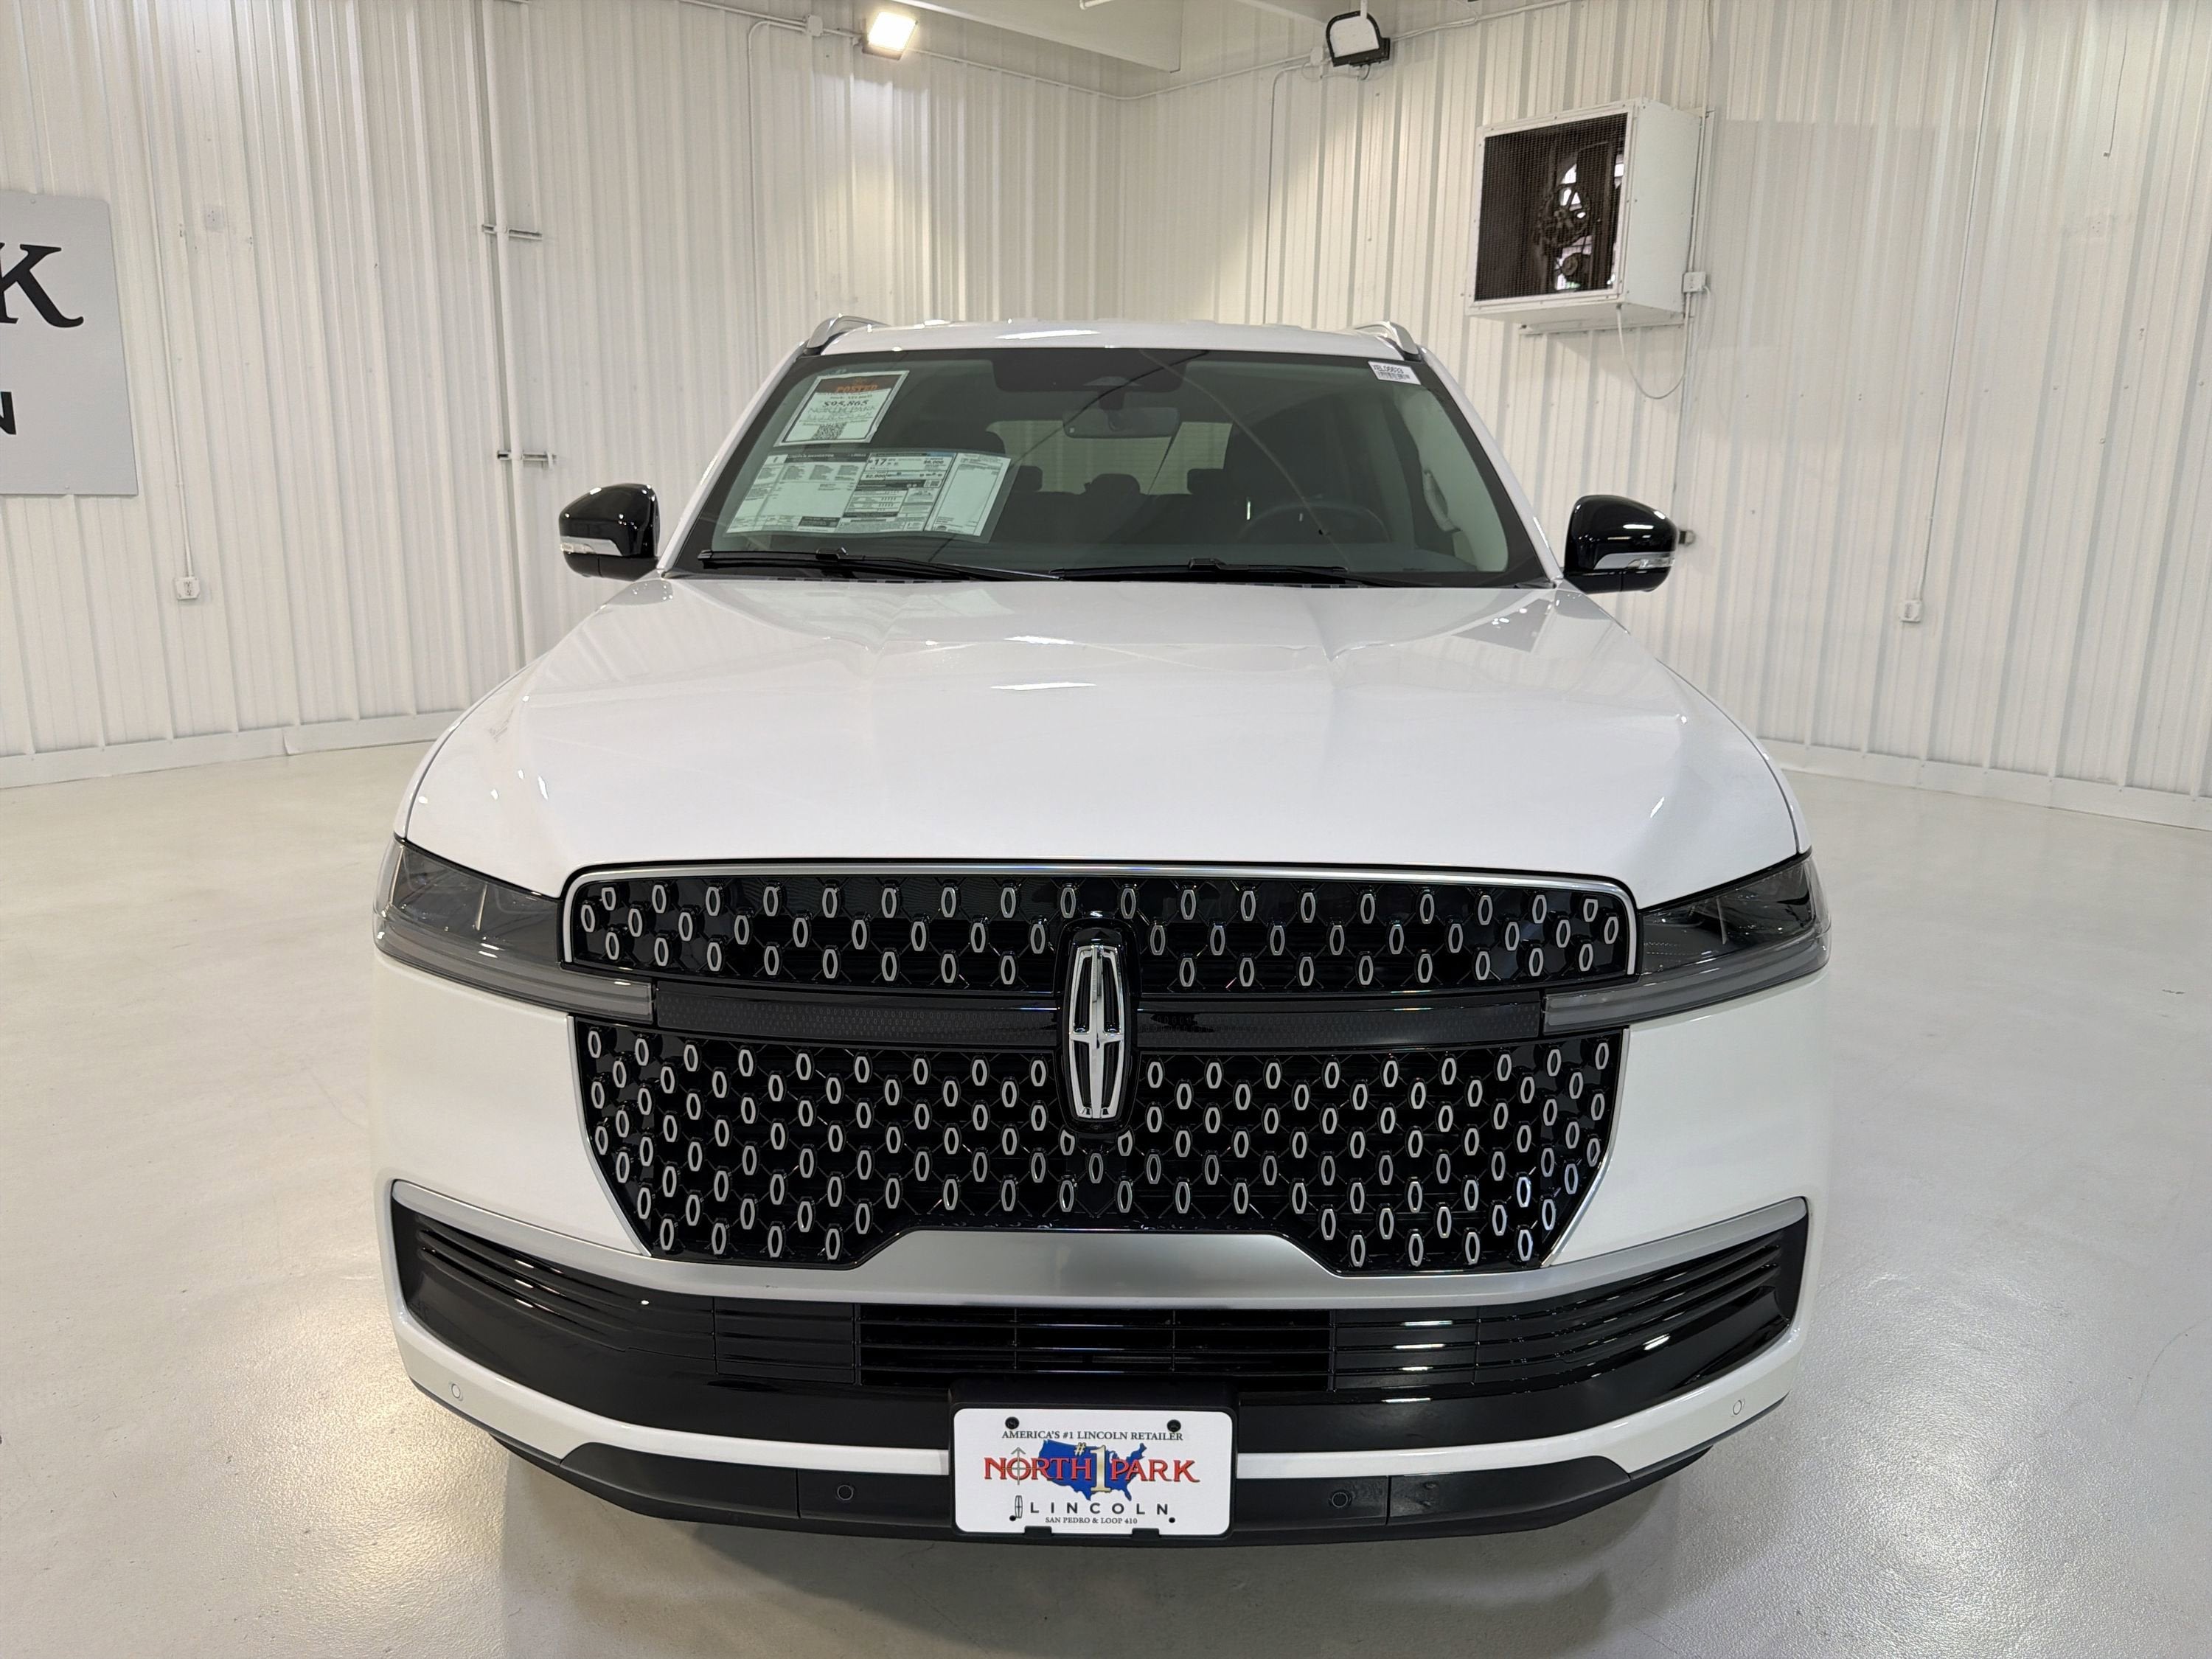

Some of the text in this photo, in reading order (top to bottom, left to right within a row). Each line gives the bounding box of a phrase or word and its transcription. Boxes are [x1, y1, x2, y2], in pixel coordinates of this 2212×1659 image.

[823, 400, 870, 408] $95,865
[1001, 1430, 1183, 1441] AMERICA'S #1 LINCOLN RETAILER
[984, 1456, 1200, 1484] NORTH PARK
[1030, 1502, 1168, 1516] LINCOLN
[1045, 1516, 1061, 1524] SAN
[1062, 1517, 1091, 1525] PEDRO
[1100, 1517, 1123, 1525] LOOP
